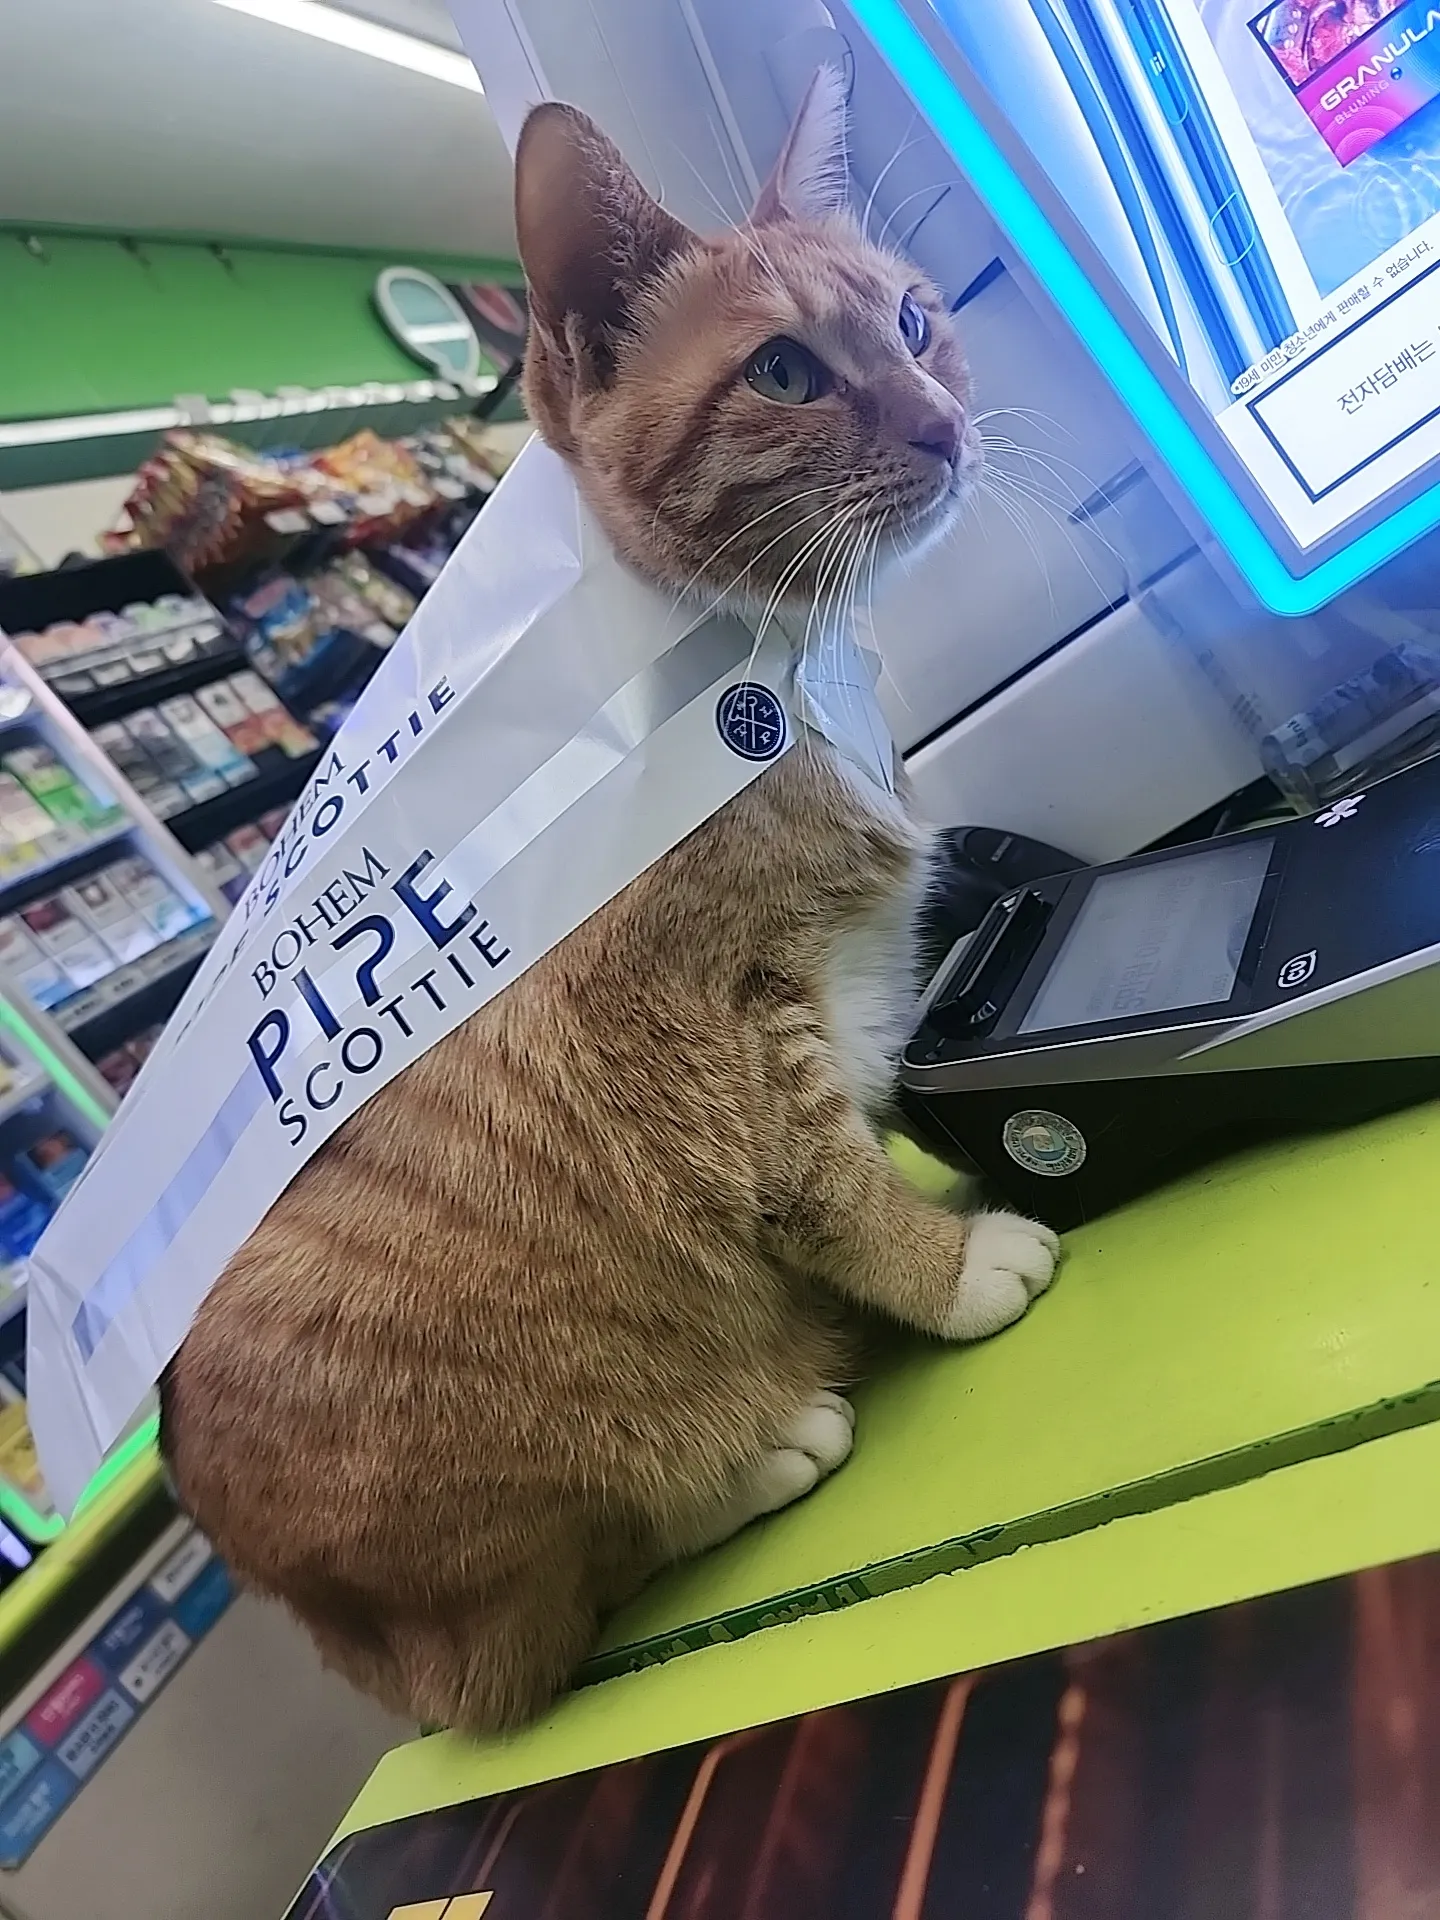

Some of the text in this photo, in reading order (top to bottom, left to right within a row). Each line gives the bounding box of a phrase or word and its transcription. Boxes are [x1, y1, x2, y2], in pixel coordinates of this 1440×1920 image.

[1334, 80, 1390, 125] BLUMING
[1260, 353, 1284, 372] 미만
[1283, 310, 1337, 355] 청소년에게
[1336, 285, 1371, 315] 판매할
[1372, 276, 1384, 289] 수
[1385, 240, 1434, 279] 없습니다.
[1336, 339, 1436, 415] 전자담배는
[264, 675, 456, 917] SCOTTIE
[251, 846, 391, 1001] BOHEM
[279, 920, 512, 1146] SCOTTIE
